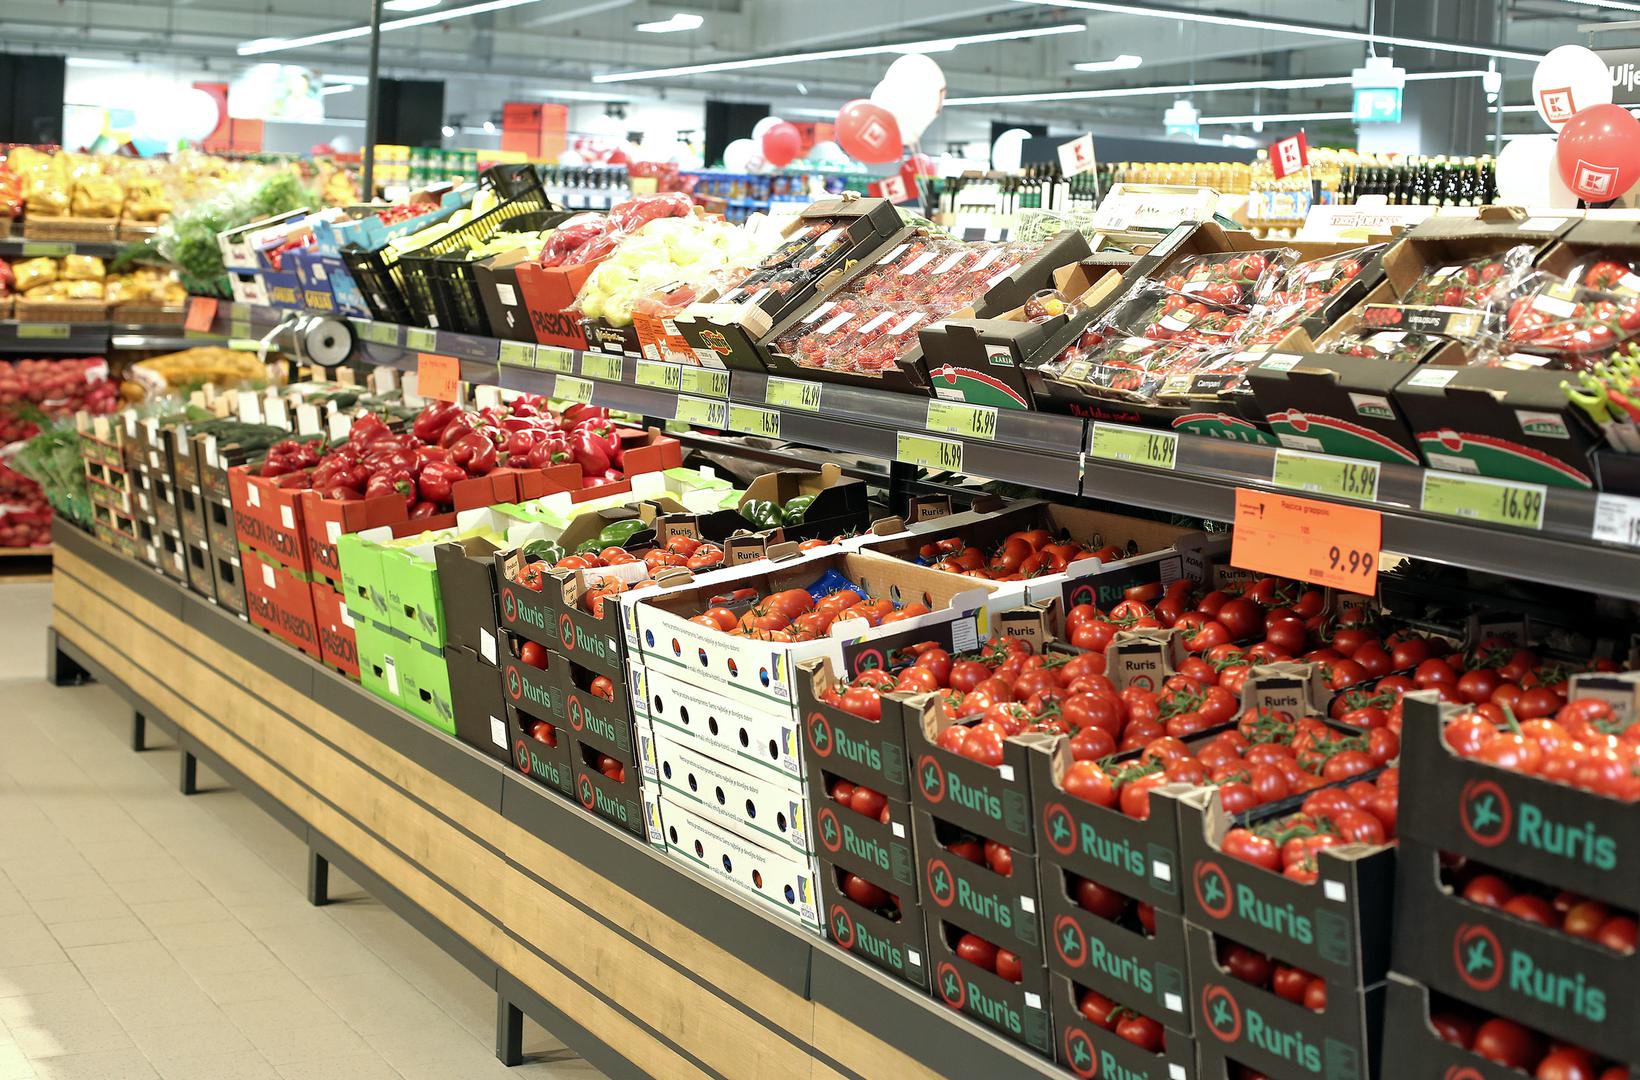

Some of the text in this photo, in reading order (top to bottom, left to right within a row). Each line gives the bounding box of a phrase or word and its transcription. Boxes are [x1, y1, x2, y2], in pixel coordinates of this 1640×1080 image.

[664, 366, 679, 386] 14.99
[712, 372, 728, 394] 12.99
[1197, 379, 1221, 389] Campari
[802, 384, 820, 407] 12.99
[762, 412, 779, 434] 16.99
[972, 409, 995, 434] 15.99
[940, 442, 962, 468] 16.99
[1148, 434, 1175, 463] 16.99
[1342, 464, 1376, 496] 15.99
[922, 508, 944, 516] Ruris
[1502, 488, 1542, 522] 16.99
[670, 528, 692, 536] Ruris
[738, 552, 760, 560] Ruris
[1329, 546, 1373, 577] 9.99
[1220, 570, 1247, 578] Ruris
[517, 599, 545, 629] Ruris
[576, 625, 605, 658] Ruris
[1007, 626, 1035, 636] Ruris
[1126, 660, 1156, 671] Ruris
[522, 677, 551, 708] Ruris
[1264, 695, 1298, 706] Ruris
[584, 707, 615, 742] Ruris
[834, 728, 881, 770] Ruris
[531, 751, 560, 785] Ruris
[595, 787, 627, 822] Ruris
[948, 772, 1002, 820] Ruris
[843, 824, 890, 870] Ruris
[1080, 822, 1146, 876] Ruris
[1518, 803, 1617, 870] Ruris
[958, 877, 1012, 928] Ruris
[1237, 883, 1313, 944] Ruris
[856, 922, 903, 969] Ruris
[1090, 936, 1153, 994] Ruris
[1510, 948, 1607, 1022] Ruris
[968, 982, 1022, 1034] Ruris
[1246, 1008, 1322, 1072] Ruris
